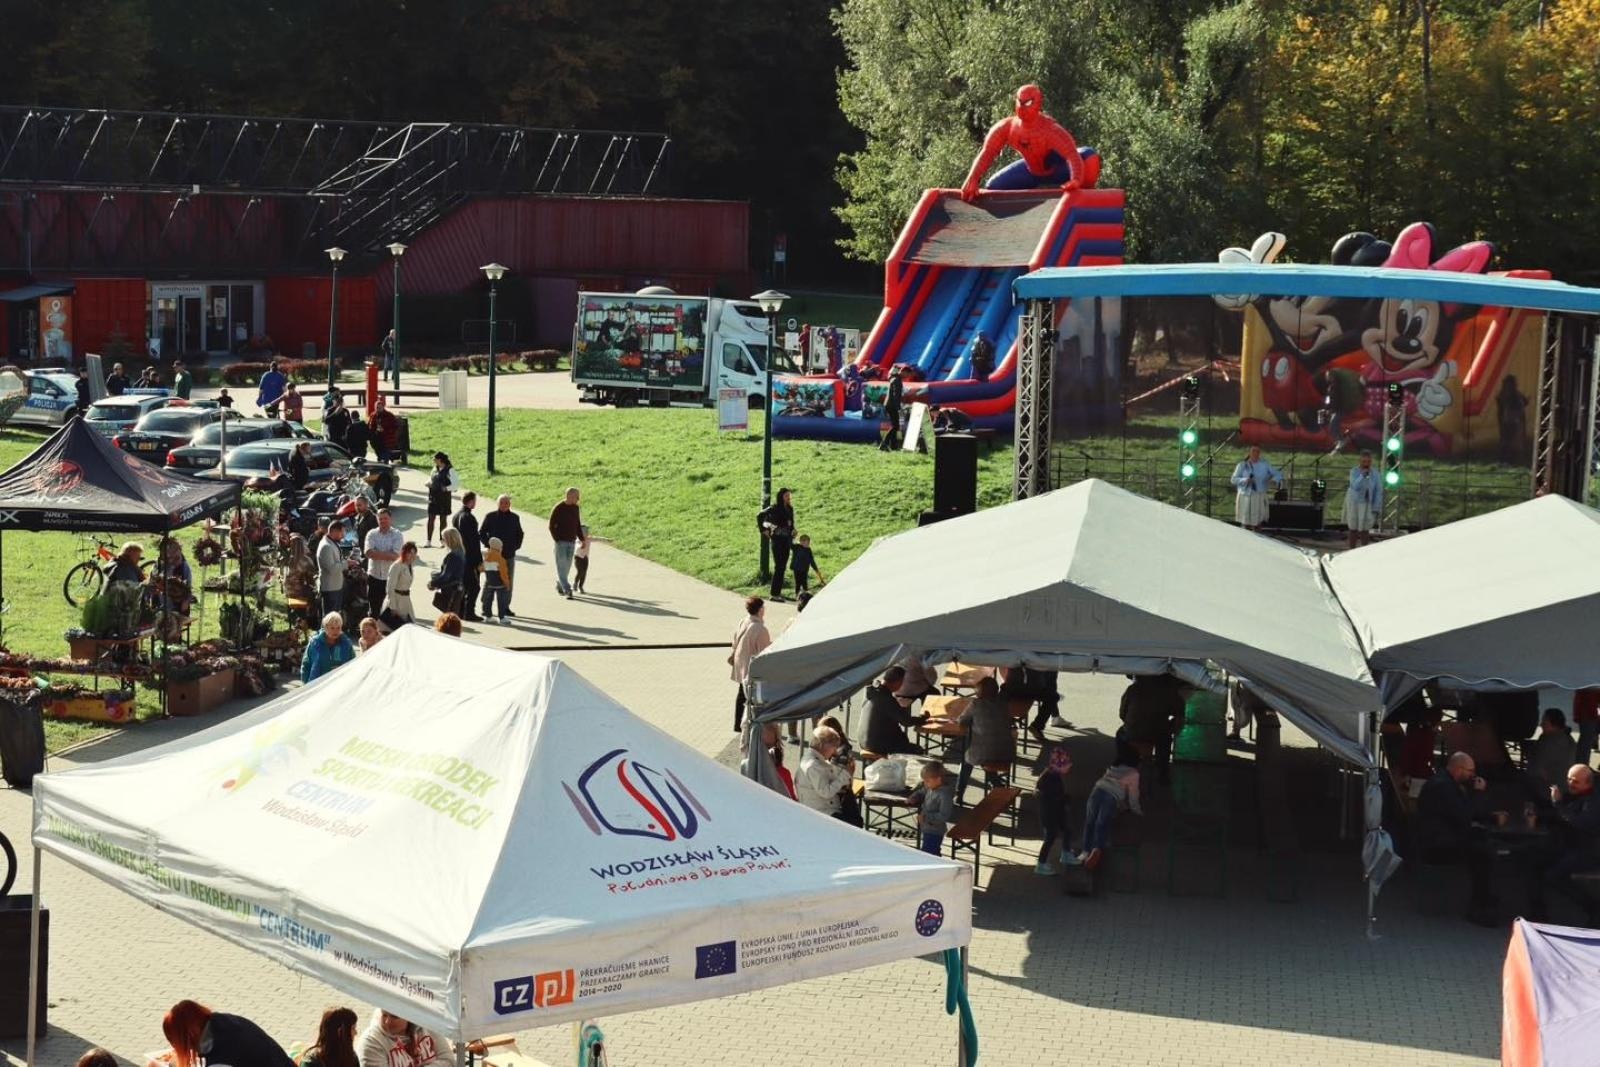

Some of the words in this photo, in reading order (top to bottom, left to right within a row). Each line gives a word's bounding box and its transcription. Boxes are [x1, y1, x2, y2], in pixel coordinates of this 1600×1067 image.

[33, 399, 57, 408] POLICJA
[286, 780, 376, 815] CENTRUM
[262, 798, 327, 829] Wodzisław
[590, 850, 714, 879] WODZISŁAW
[717, 845, 780, 863] ŚLĄSKI
[87, 832, 139, 871] OŚRODEK
[189, 881, 251, 921] REKREACJI
[333, 950, 342, 961] w
[343, 951, 399, 986] Wodzisławiu
[399, 972, 435, 1001] Śląskim
[777, 933, 793, 942] UNIE
[800, 928, 817, 938] UNIA
[818, 919, 860, 935] EUROPEJSKA
[741, 954, 782, 969] EUROPEJSKI
[783, 948, 814, 961] FUNDUSZ
[815, 943, 847, 955] ROZWOJU
[777, 942, 796, 951] FOND
[797, 939, 812, 948] PRO
[638, 955, 671, 968] HRANICE
[580, 972, 638, 988] PRZEKRACZAMY
[638, 965, 671, 978] GRANICE
